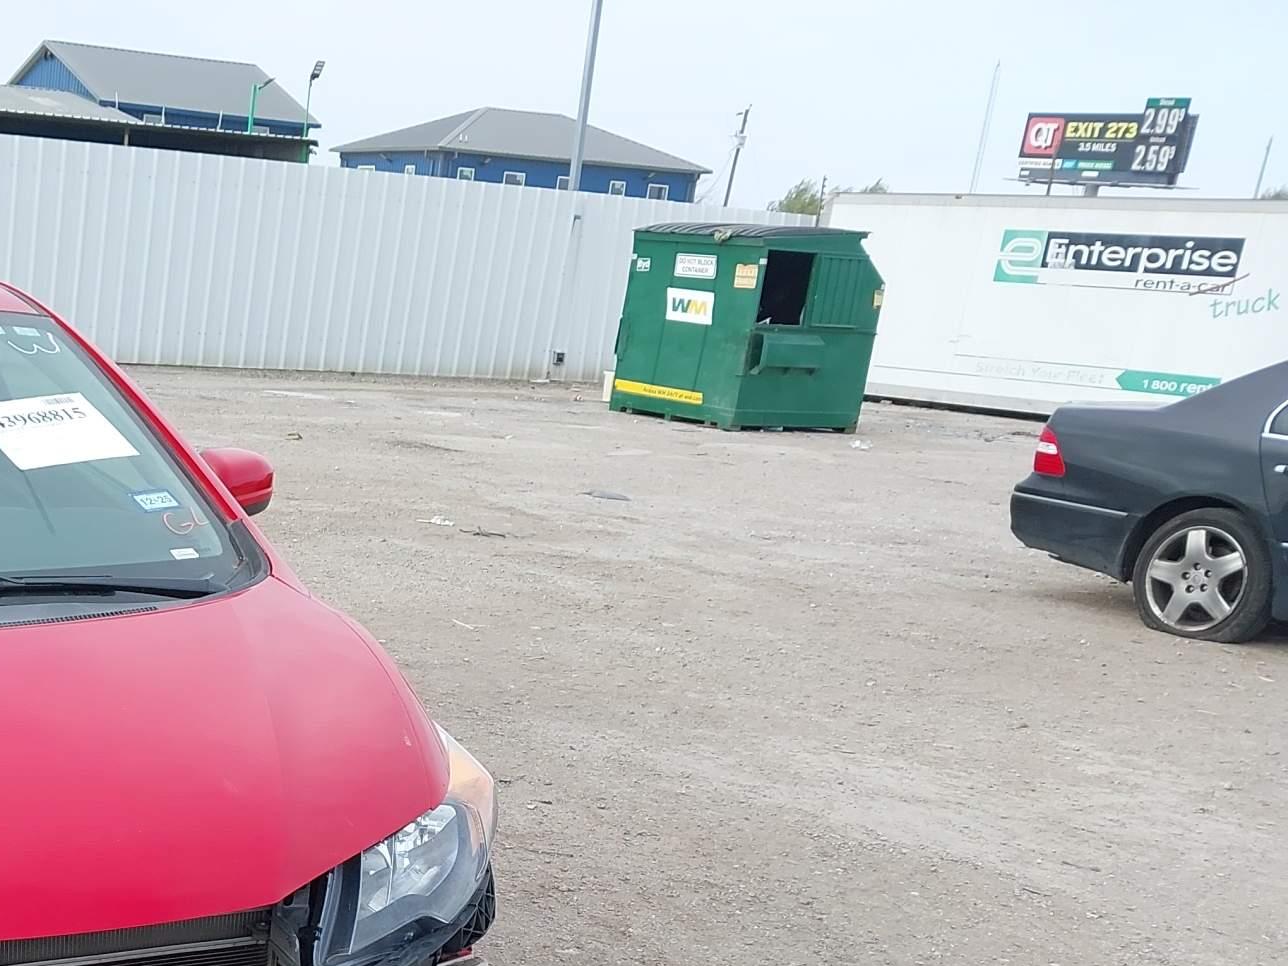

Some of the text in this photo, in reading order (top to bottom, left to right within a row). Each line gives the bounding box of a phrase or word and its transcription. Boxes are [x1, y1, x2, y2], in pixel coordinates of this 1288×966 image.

[1029, 122, 1059, 149] QT
[1065, 122, 1139, 138] EXIT 273
[1092, 143, 1117, 152] MILES
[1046, 238, 1237, 274] Enterprise
[672, 297, 708, 316] WM
[1210, 288, 1280, 319] truck
[1151, 379, 1177, 391] 800
